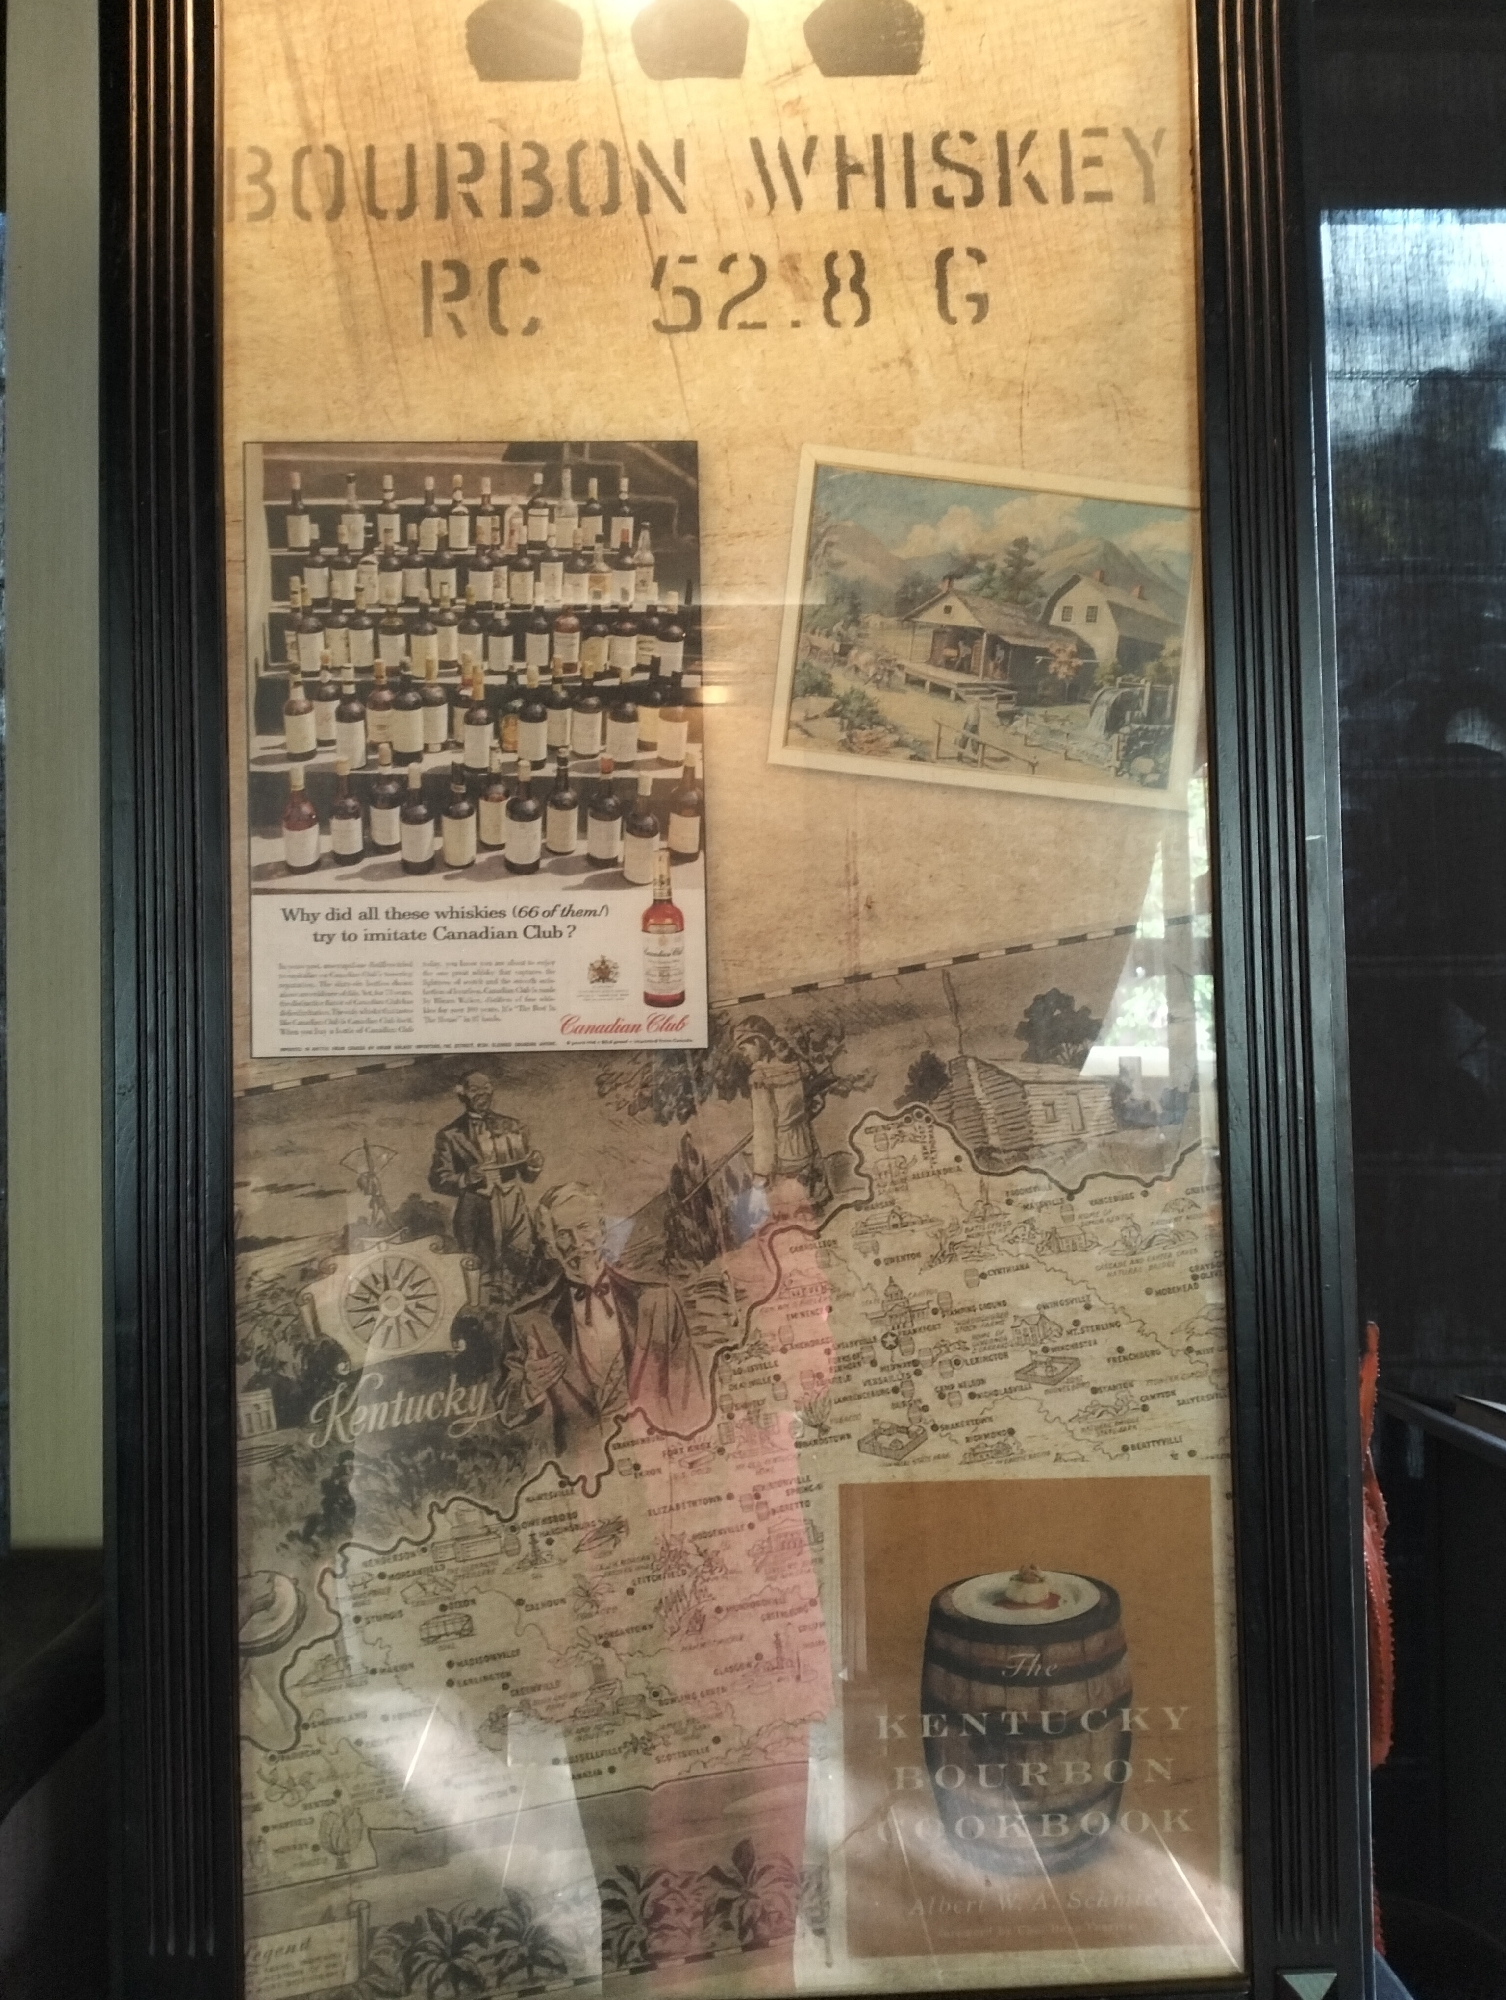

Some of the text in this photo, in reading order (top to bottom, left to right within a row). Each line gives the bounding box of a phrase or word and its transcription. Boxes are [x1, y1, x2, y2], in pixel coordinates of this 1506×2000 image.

[226, 126, 1167, 223] BOURBON WHISKEY
[421, 246, 990, 337] RC 52.8 G
[280, 907, 321, 924] Why
[325, 906, 352, 921] did
[358, 906, 380, 920] all
[385, 906, 430, 920] these
[434, 905, 507, 920] whiskies
[512, 904, 539, 919] (66
[541, 904, 560, 920] of
[313, 929, 337, 945] try
[341, 929, 358, 942] to
[363, 927, 427, 942] imitate
[433, 925, 518, 940] Canadian
[560, 1012, 690, 1035] Canadian Club
[1155, 1282, 1199, 1297] MOREHEAD
[308, 1372, 502, 1449] Kentucky
[1002, 1652, 1058, 1678] The
[876, 1706, 1189, 1741] KENTUCKY
[894, 1757, 1175, 1792] BOURBON
[877, 1808, 1194, 1844] COOKBOOK
[908, 1895, 983, 1916] Albert
